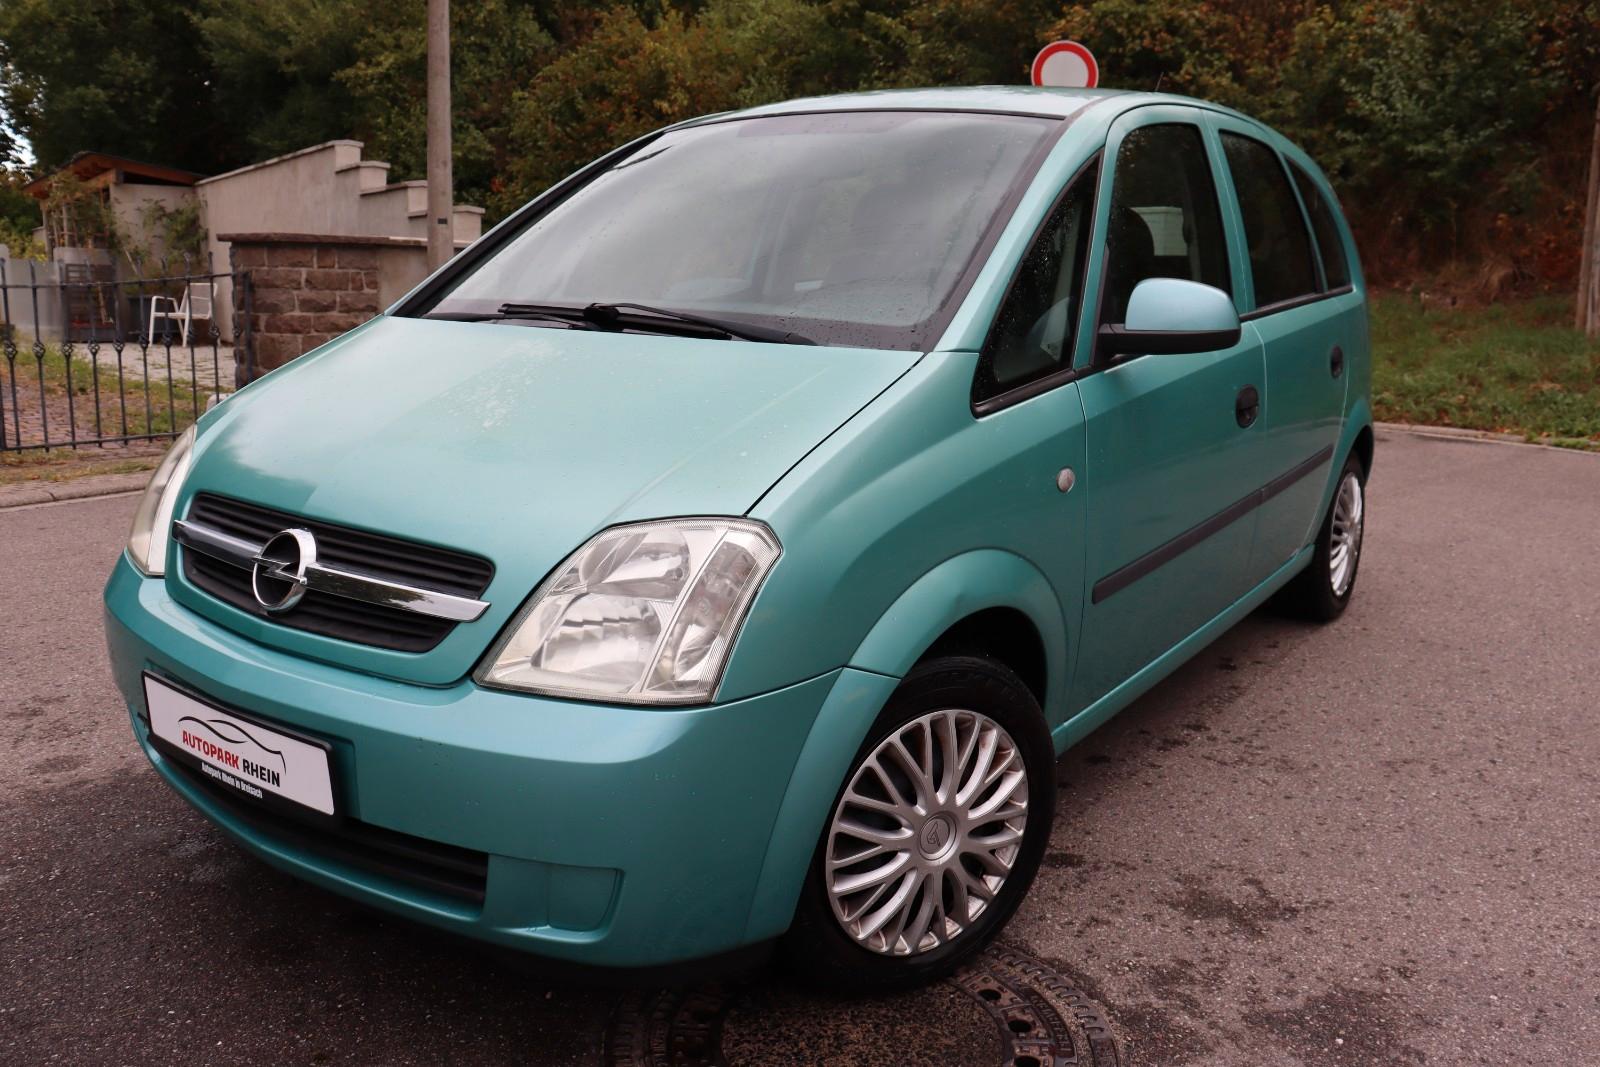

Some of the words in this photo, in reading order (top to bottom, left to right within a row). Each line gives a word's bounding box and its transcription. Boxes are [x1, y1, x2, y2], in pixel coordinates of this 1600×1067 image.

[182, 730, 240, 770] AUTOPARK
[242, 758, 280, 788] RHEIN
[201, 761, 222, 781] Autopark
[221, 771, 235, 788] Rhein
